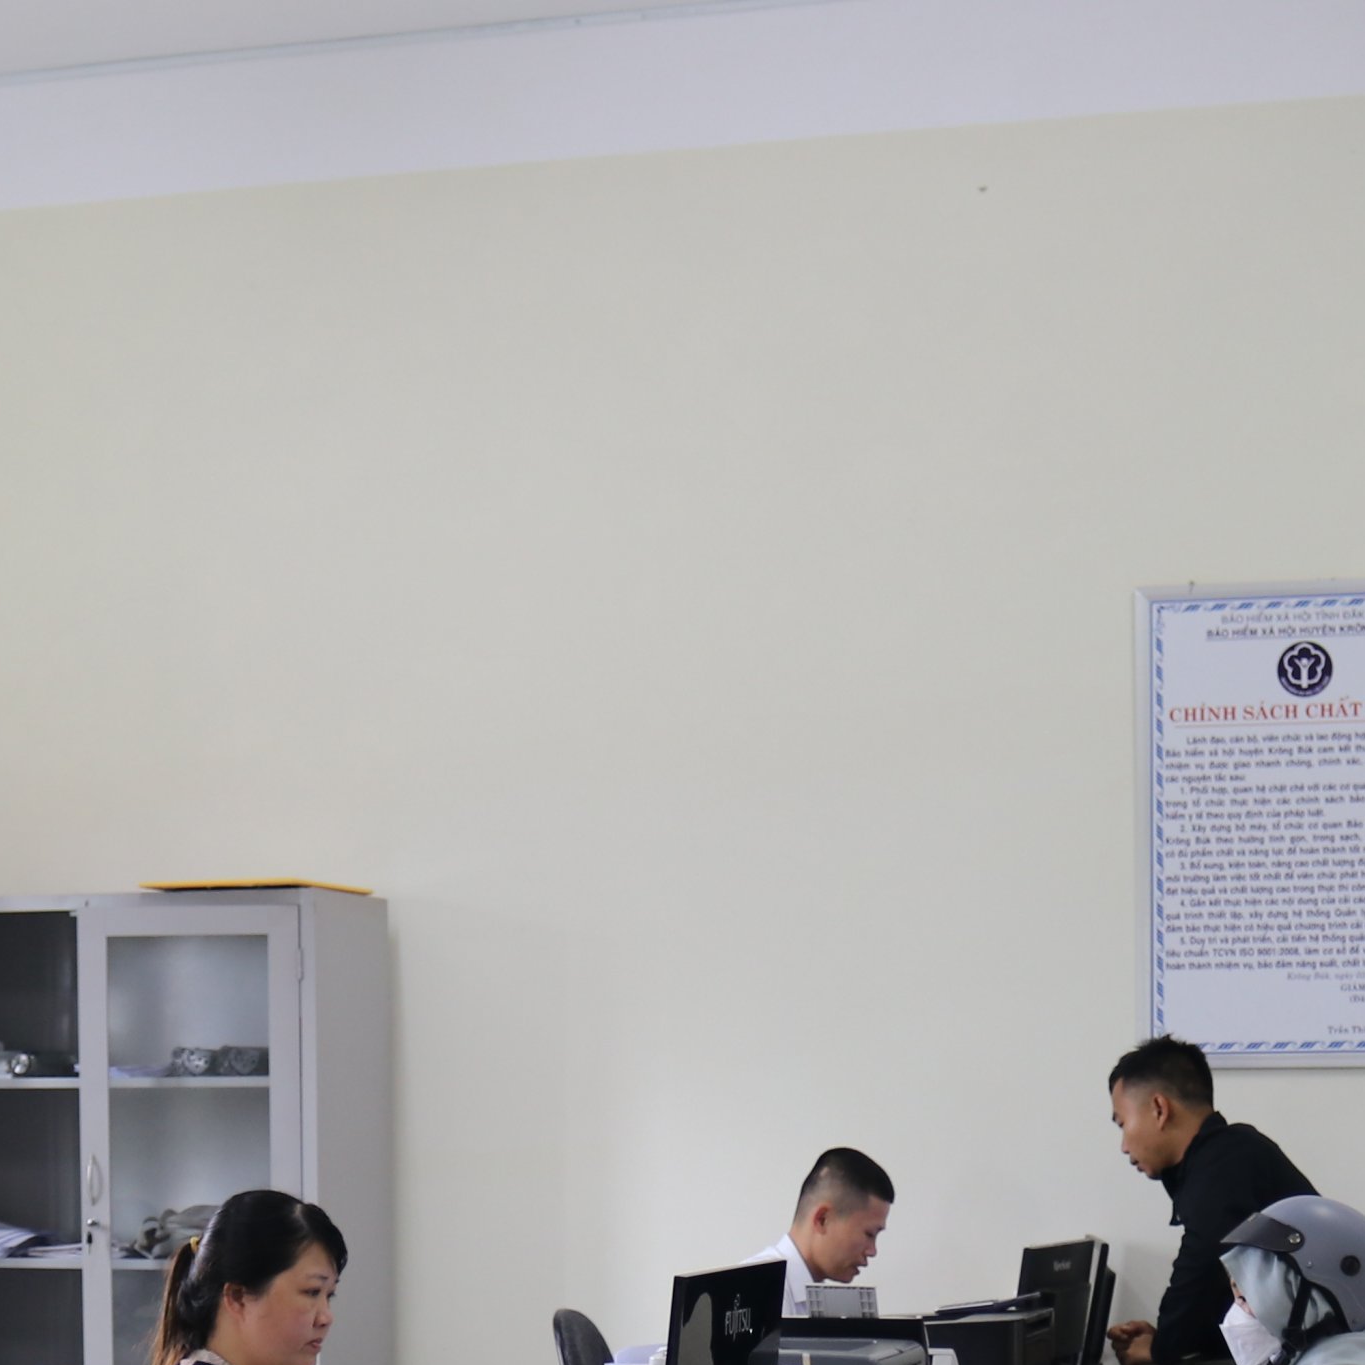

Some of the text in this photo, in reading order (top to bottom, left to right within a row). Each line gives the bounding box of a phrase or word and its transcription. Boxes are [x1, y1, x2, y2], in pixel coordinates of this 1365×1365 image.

[1206, 626, 1229, 639] BẢO
[1232, 625, 1258, 638] HIỂM
[1278, 624, 1296, 638] HỘI
[1299, 623, 1336, 637] HUYỆN
[1169, 702, 1237, 723] CHÍNH
[1242, 700, 1299, 721] SÁCH
[1305, 694, 1363, 719] CHẤT
